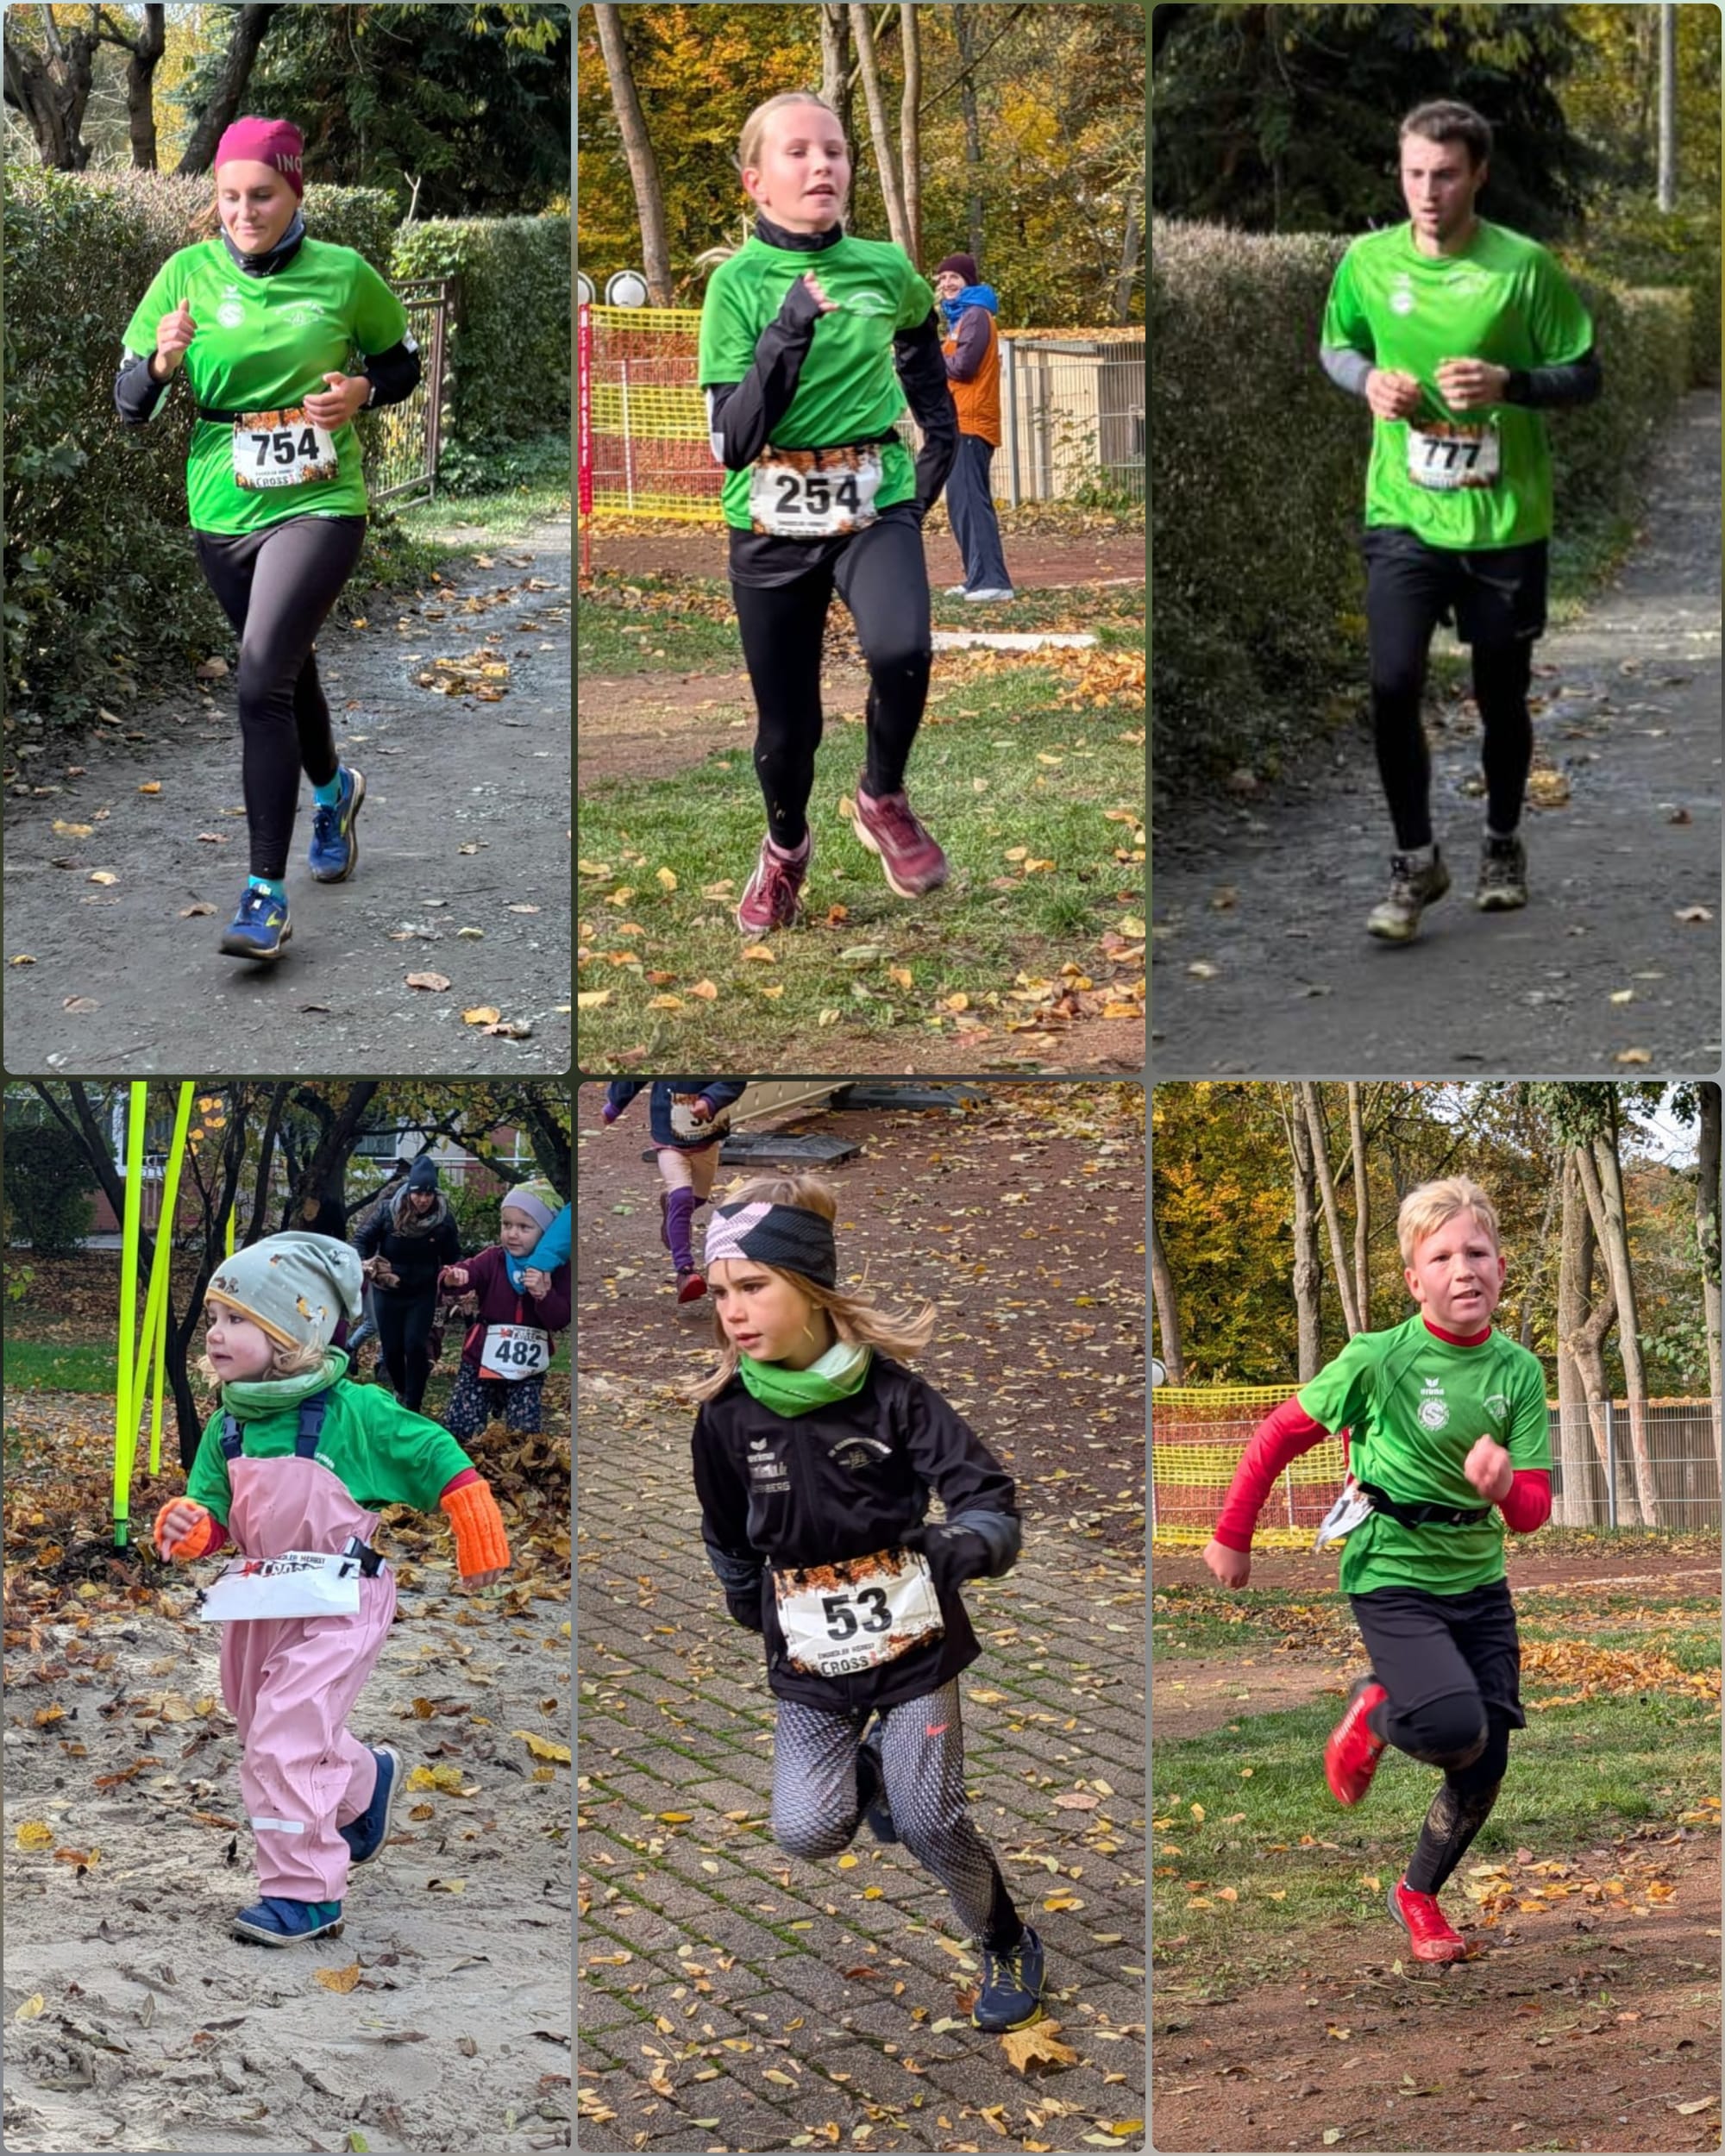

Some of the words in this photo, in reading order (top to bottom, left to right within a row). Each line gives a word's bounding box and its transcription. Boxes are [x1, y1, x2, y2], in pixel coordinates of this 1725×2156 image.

[251, 428, 319, 467] 754
[1422, 439, 1480, 469] 777
[775, 474, 861, 515] 254
[495, 1340, 542, 1368] 482
[822, 1588, 893, 1640] 53
[821, 1656, 869, 1675] CROSS
